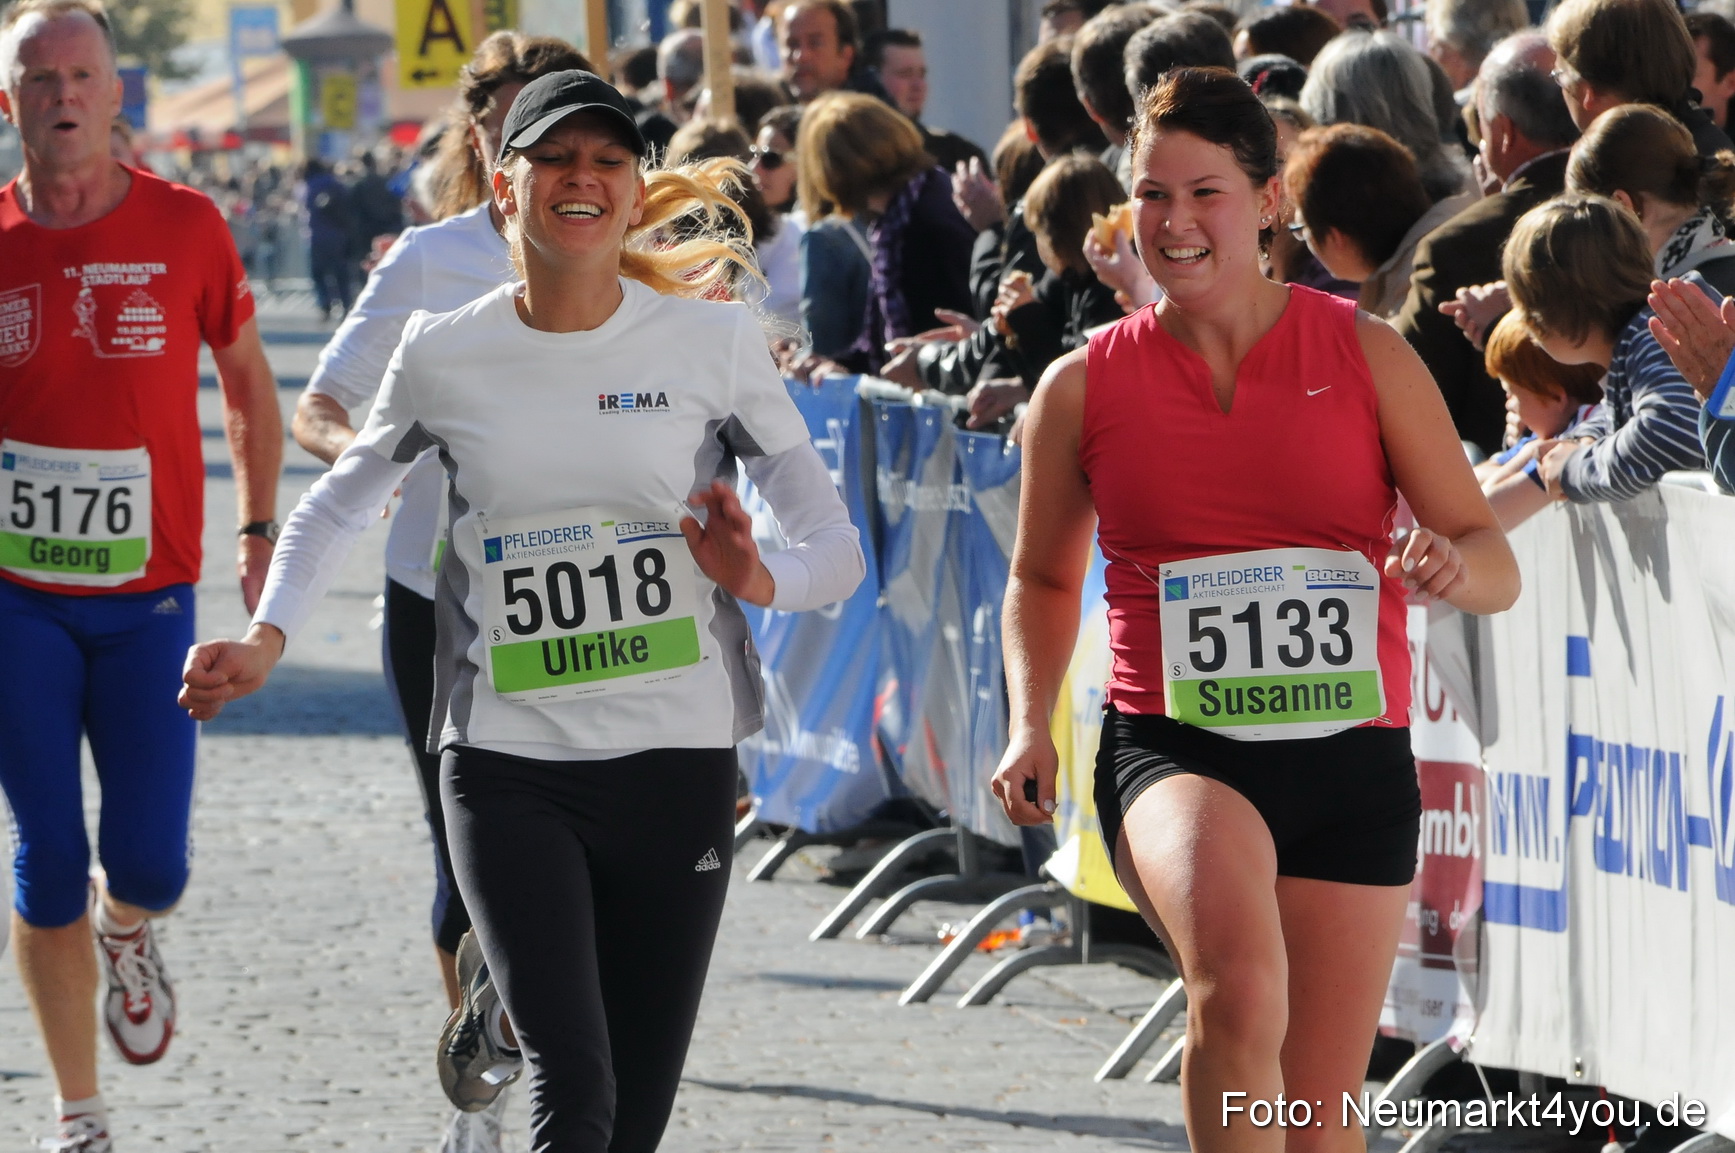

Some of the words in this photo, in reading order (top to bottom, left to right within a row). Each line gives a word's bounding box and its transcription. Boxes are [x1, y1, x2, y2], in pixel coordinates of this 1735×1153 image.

[419, 0, 466, 55] A
[82, 263, 167, 274] NEUMARKTER
[81, 273, 152, 287] STADTLAUF
[11, 479, 131, 535] 5176
[504, 524, 594, 550] PFLEIDERER
[615, 521, 670, 536] BOCK
[30, 537, 110, 573] Georg
[505, 542, 595, 561] AKTIENGESELLSCHAFT
[1192, 566, 1285, 589] PFLEIDERER
[1305, 569, 1360, 582] BOCK
[503, 547, 672, 636] 5018
[1192, 584, 1285, 599] AKTIENGESELLSCHAFT
[493, 629, 501, 642] S
[1188, 597, 1353, 673] 5133
[541, 631, 649, 676] Ulrike
[1173, 665, 1181, 677] S
[1198, 679, 1353, 717] Susanne
[695, 861, 720, 871] adidas
